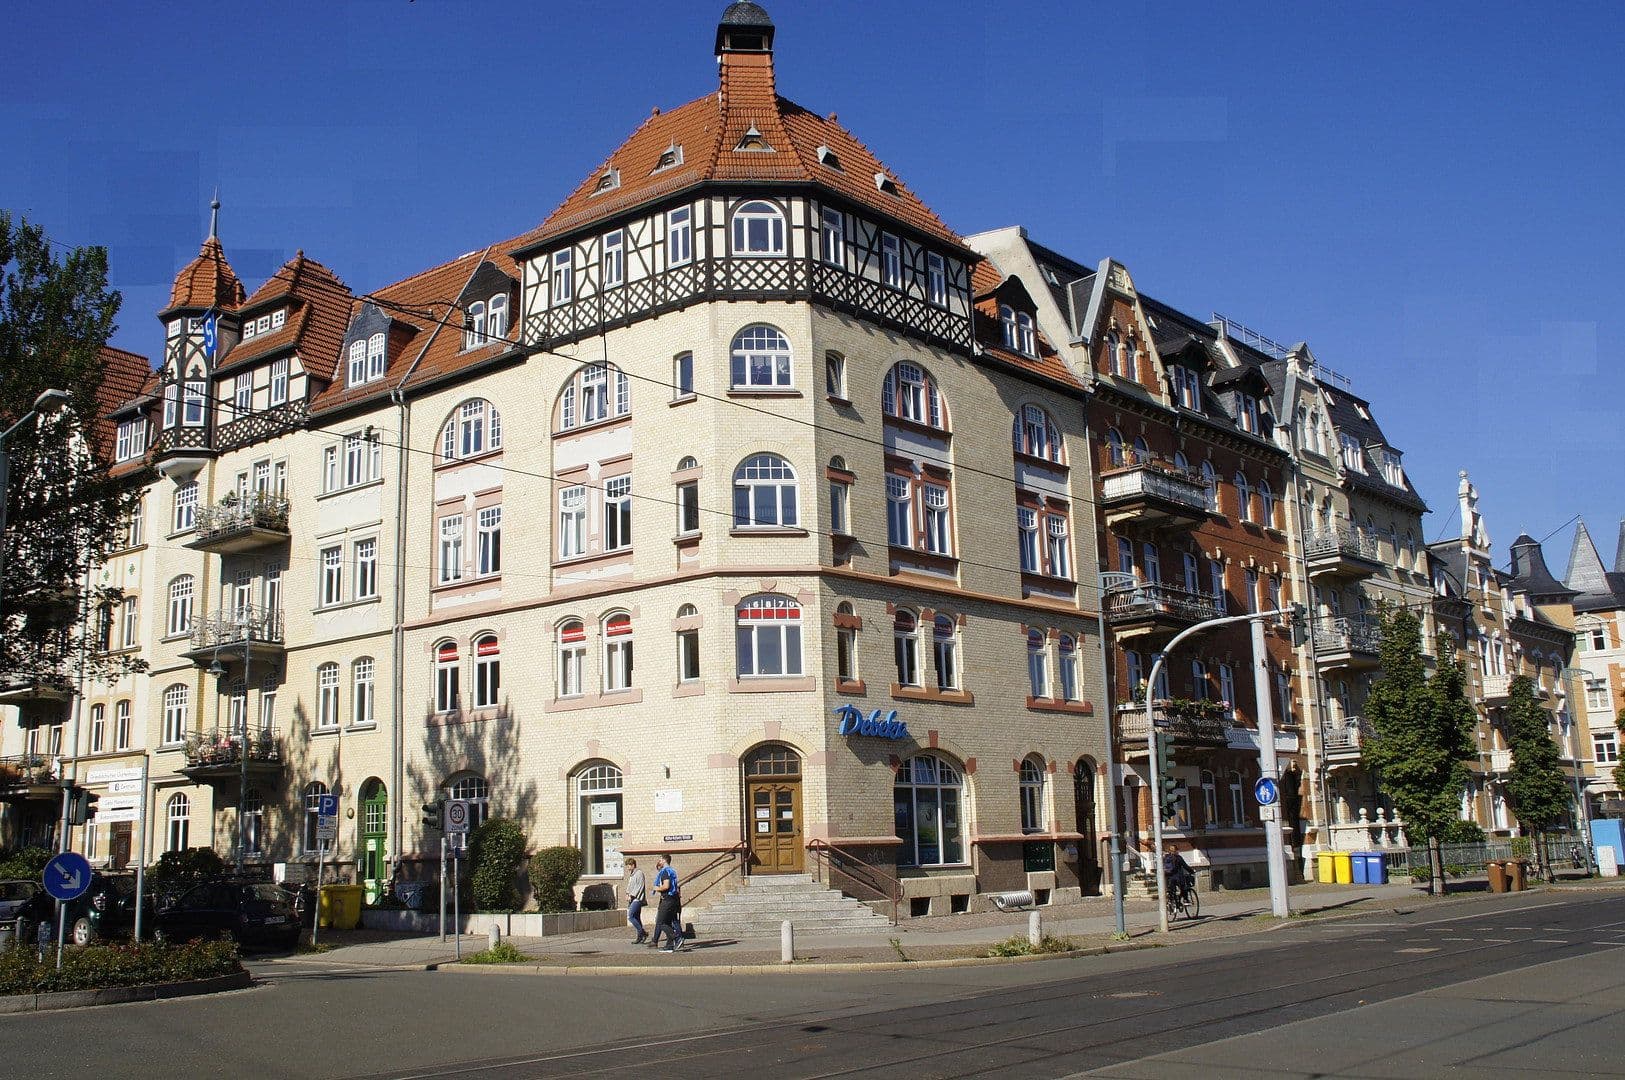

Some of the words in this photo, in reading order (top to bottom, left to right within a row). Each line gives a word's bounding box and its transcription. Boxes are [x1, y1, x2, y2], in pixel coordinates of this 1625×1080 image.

[831, 704, 908, 740] Debeka
[322, 797, 334, 813] P
[452, 809, 462, 819] 30
